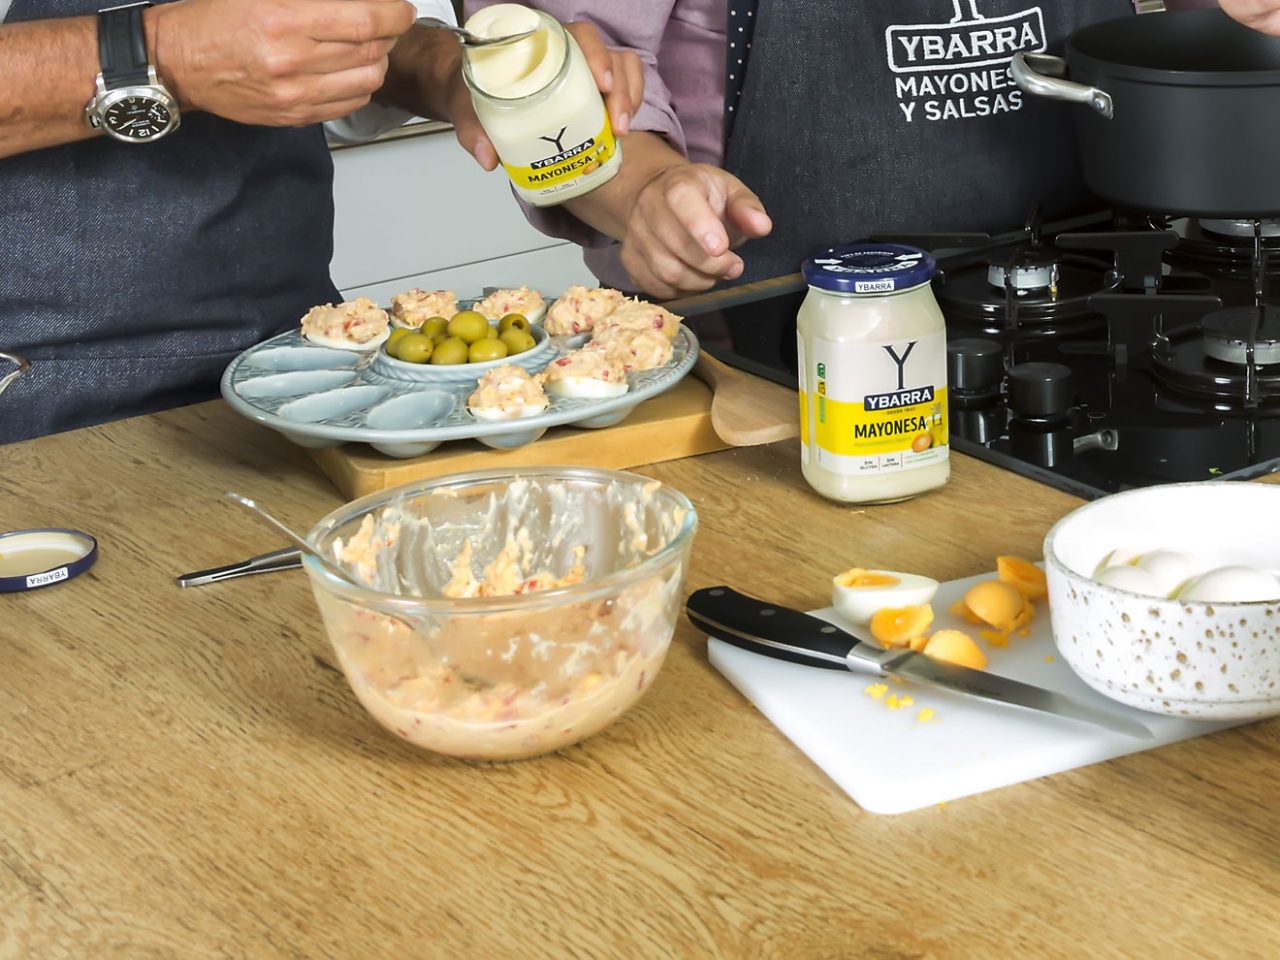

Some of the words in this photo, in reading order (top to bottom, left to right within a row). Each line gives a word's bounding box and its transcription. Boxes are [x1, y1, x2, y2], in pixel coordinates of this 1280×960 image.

[898, 22, 1039, 61] YBARRA
[899, 101, 916, 122] Y
[925, 90, 1023, 121] SALSAS
[537, 126, 569, 153] Y
[533, 142, 592, 168] YBARRA
[527, 154, 593, 183] MAYONESA
[857, 283, 892, 292] YBARRA
[881, 340, 919, 391] Y
[867, 389, 932, 409] YBARRA
[854, 415, 927, 440] MAYONESA
[30, 570, 66, 584] YBARRA
